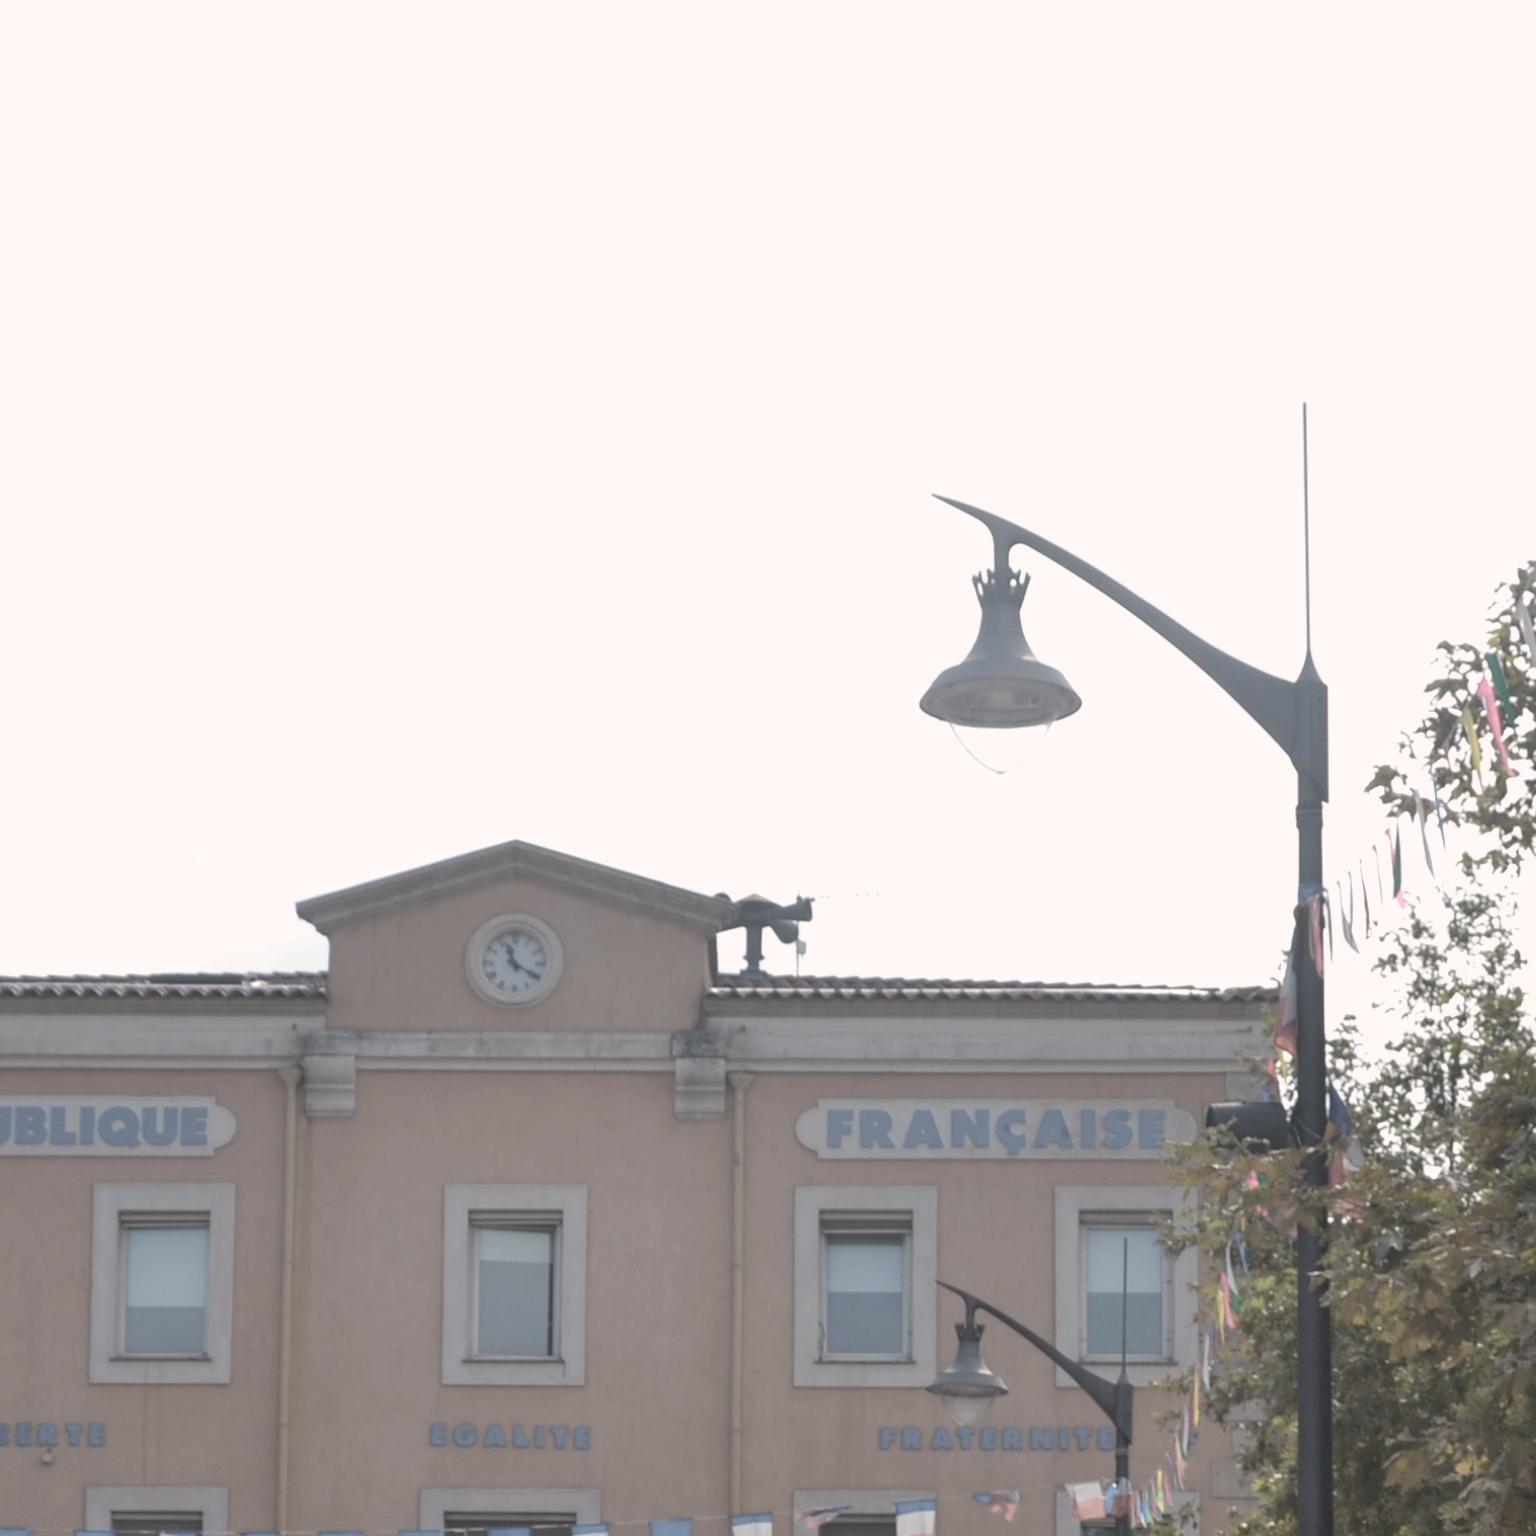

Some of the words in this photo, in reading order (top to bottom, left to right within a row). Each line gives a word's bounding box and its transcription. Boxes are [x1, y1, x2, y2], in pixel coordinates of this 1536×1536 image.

[826, 1109, 1167, 1155] FRANÇAISE
[429, 1423, 591, 1450] EGALITE
[878, 1427, 1114, 1450] FRATERNITE
